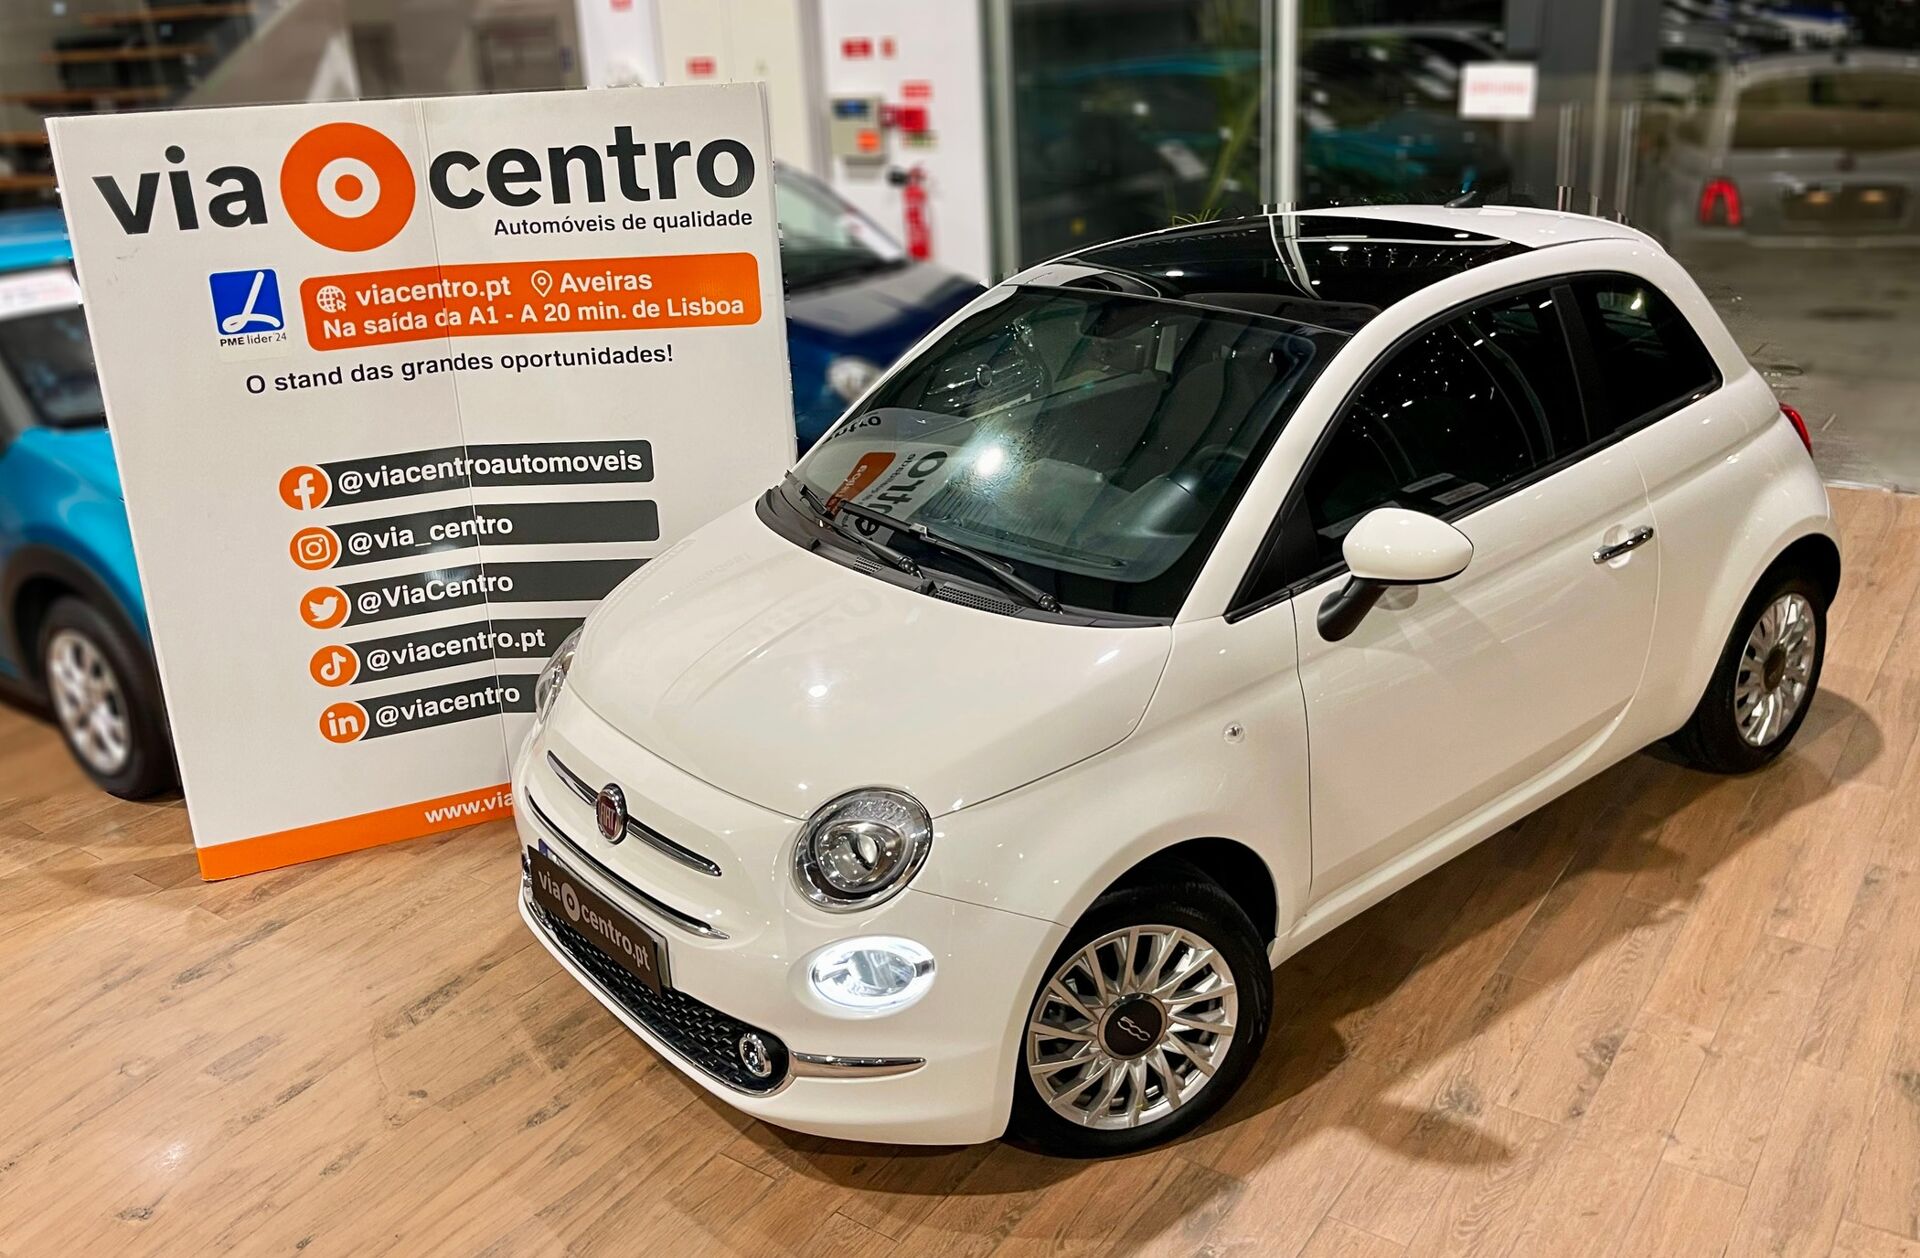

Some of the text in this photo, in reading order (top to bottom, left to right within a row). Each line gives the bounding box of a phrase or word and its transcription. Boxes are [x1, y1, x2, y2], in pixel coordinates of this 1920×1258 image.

[92, 125, 756, 235] via centro
[494, 210, 753, 236] Automóveis de qualidade
[356, 276, 512, 306] viacentro.pt
[559, 271, 653, 294] Aveiras
[322, 318, 357, 339] Na
[363, 312, 428, 335] saída
[434, 307, 462, 326] da
[469, 305, 499, 325] A1
[520, 304, 538, 323] A
[543, 303, 571, 322] 20
[578, 301, 627, 321] min.
[632, 299, 661, 319] de
[667, 297, 744, 318] Lisboa
[220, 336, 245, 347] PME
[246, 344, 673, 395] O stand das grandes oportunidades!
[338, 449, 643, 495] @viacentroautomoveis
[347, 512, 513, 555] @via_centro
[357, 574, 513, 614] @ViaCentro
[366, 628, 546, 673] @viacentro.pt
[375, 685, 521, 728] @viacentro
[601, 802, 616, 831] FIAT
[538, 871, 650, 971] via centro.pt
